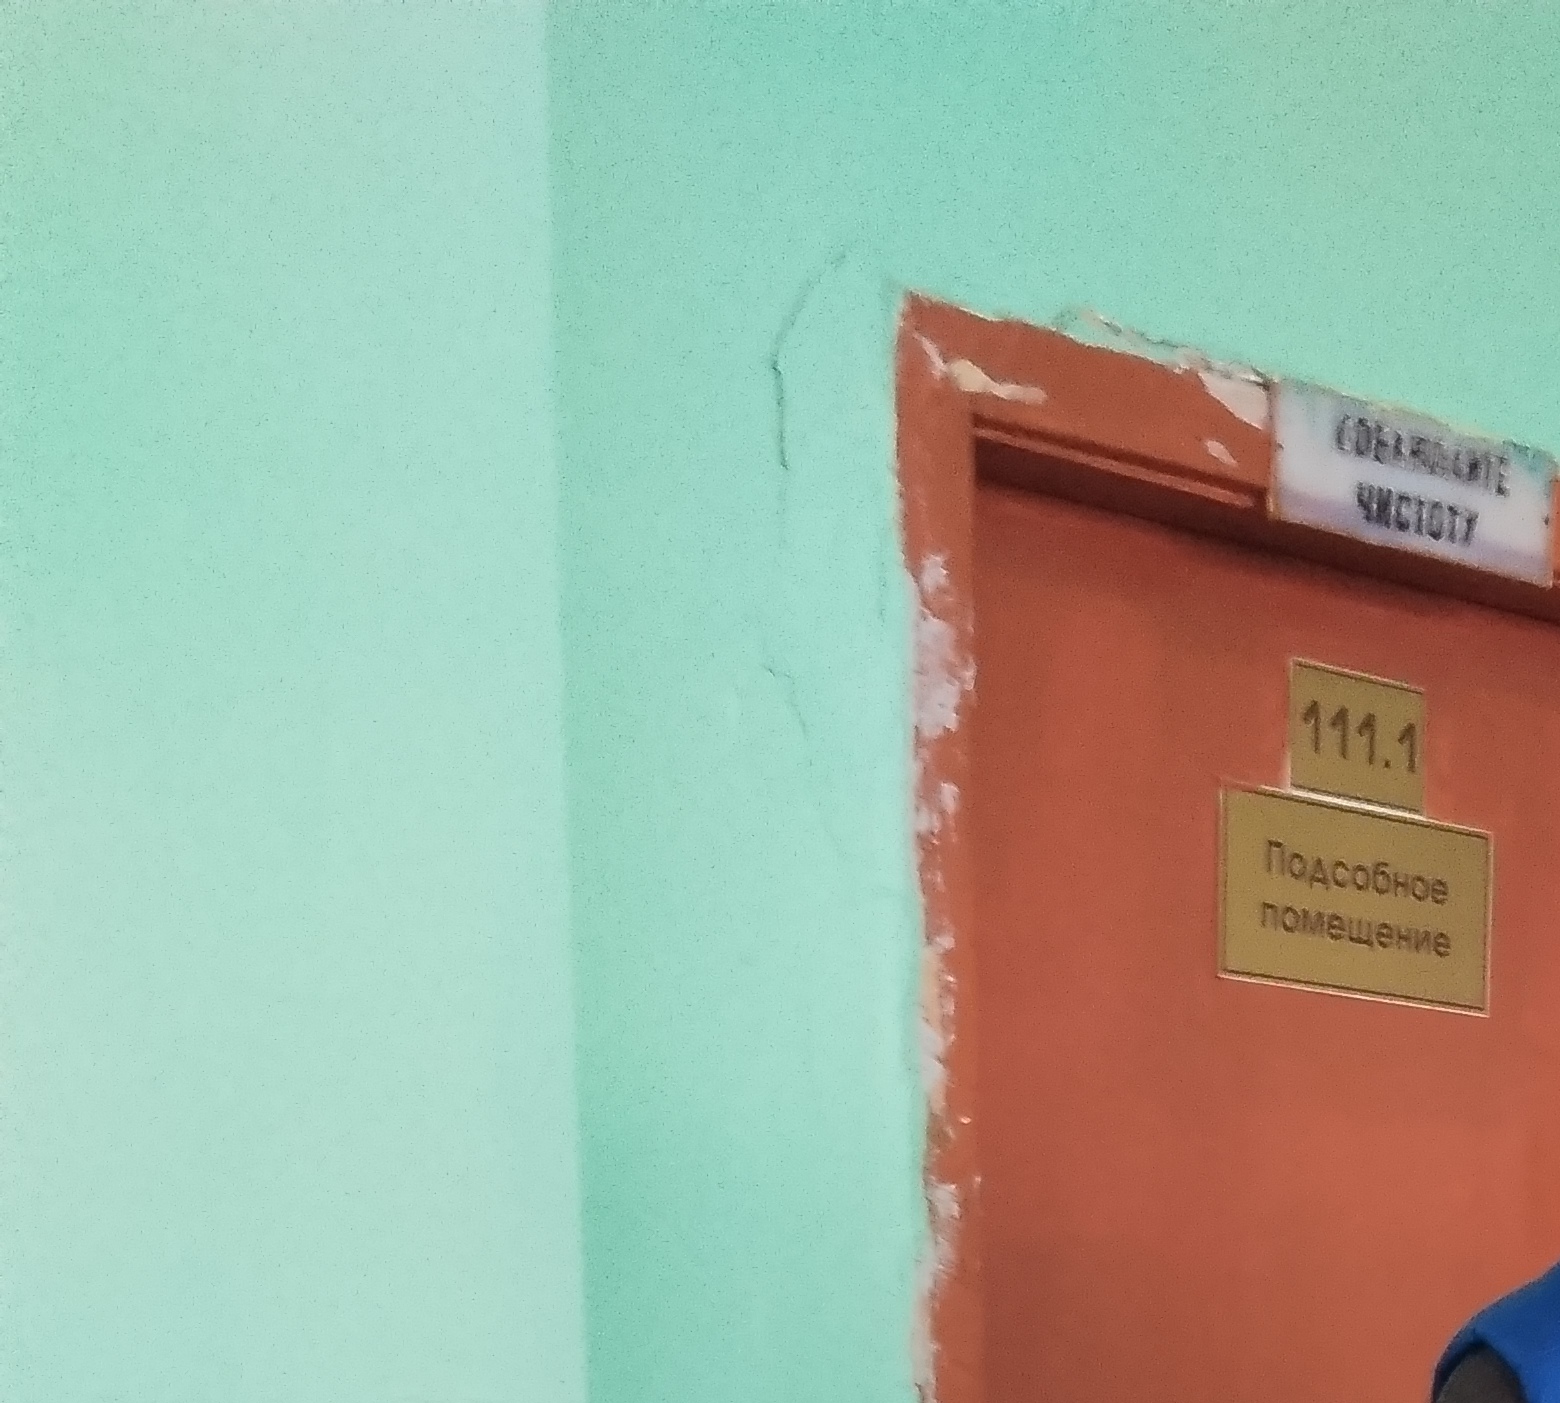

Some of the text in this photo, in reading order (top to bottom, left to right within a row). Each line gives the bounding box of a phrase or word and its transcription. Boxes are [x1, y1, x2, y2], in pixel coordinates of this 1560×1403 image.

[1303, 699, 1418, 773] 111.1
[1265, 837, 1449, 907] Подсобное
[1259, 900, 1453, 959] помещение
